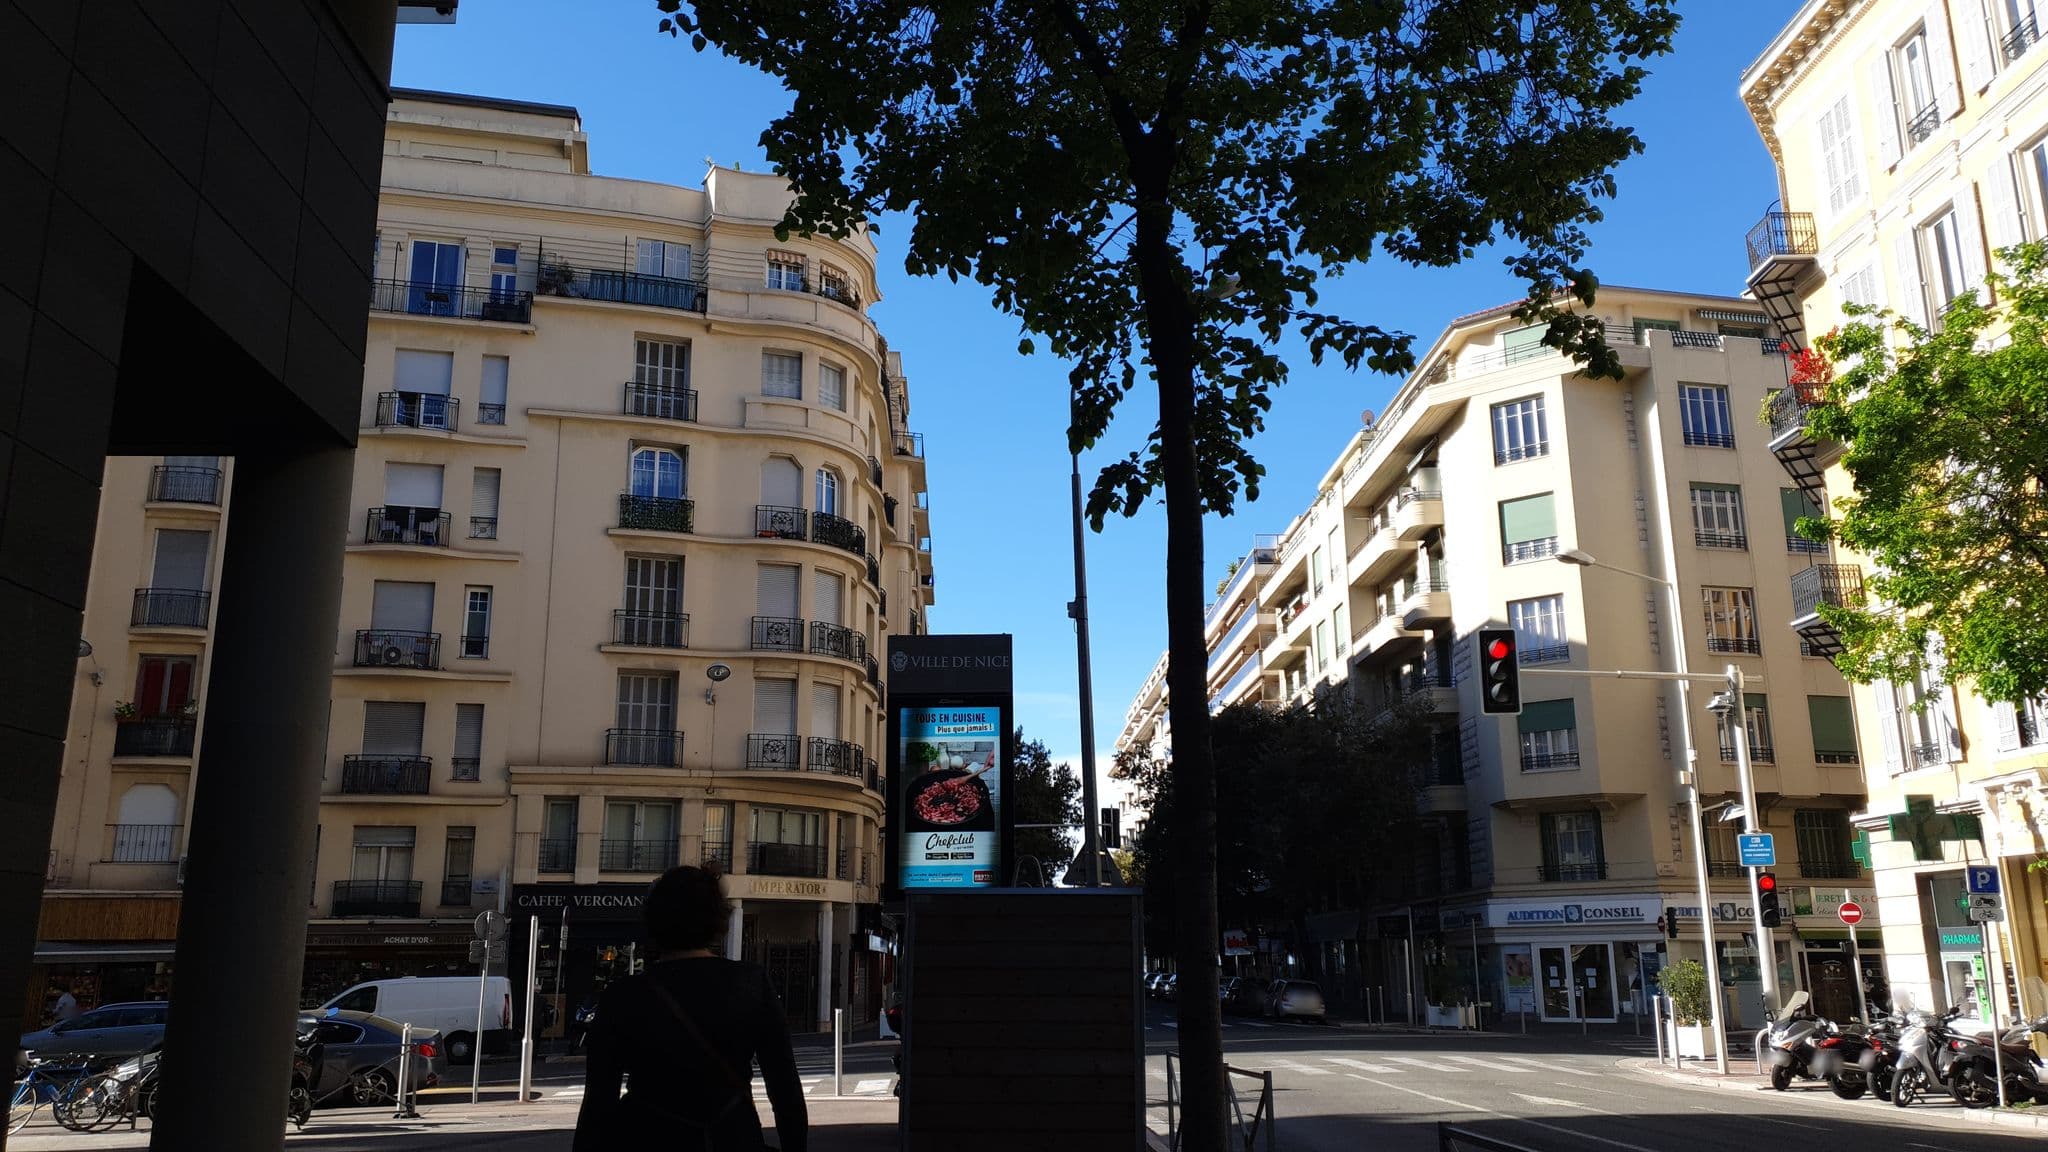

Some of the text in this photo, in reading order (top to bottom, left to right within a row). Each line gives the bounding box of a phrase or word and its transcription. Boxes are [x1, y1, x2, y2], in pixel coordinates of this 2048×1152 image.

[911, 655, 1009, 668] VILLE DE NICE
[915, 713, 986, 724] TOUS EN CUISINE
[937, 725, 951, 733] Plus
[953, 726, 965, 734] que
[966, 724, 988, 734] jamais
[926, 833, 975, 850] Chefclub
[1976, 871, 1991, 889] P
[752, 880, 821, 894] IMPERATOR
[1507, 907, 1645, 921] AUDITION CONSEIL
[384, 936, 410, 944] ACHAT
[411, 936, 429, 944] D'OR
